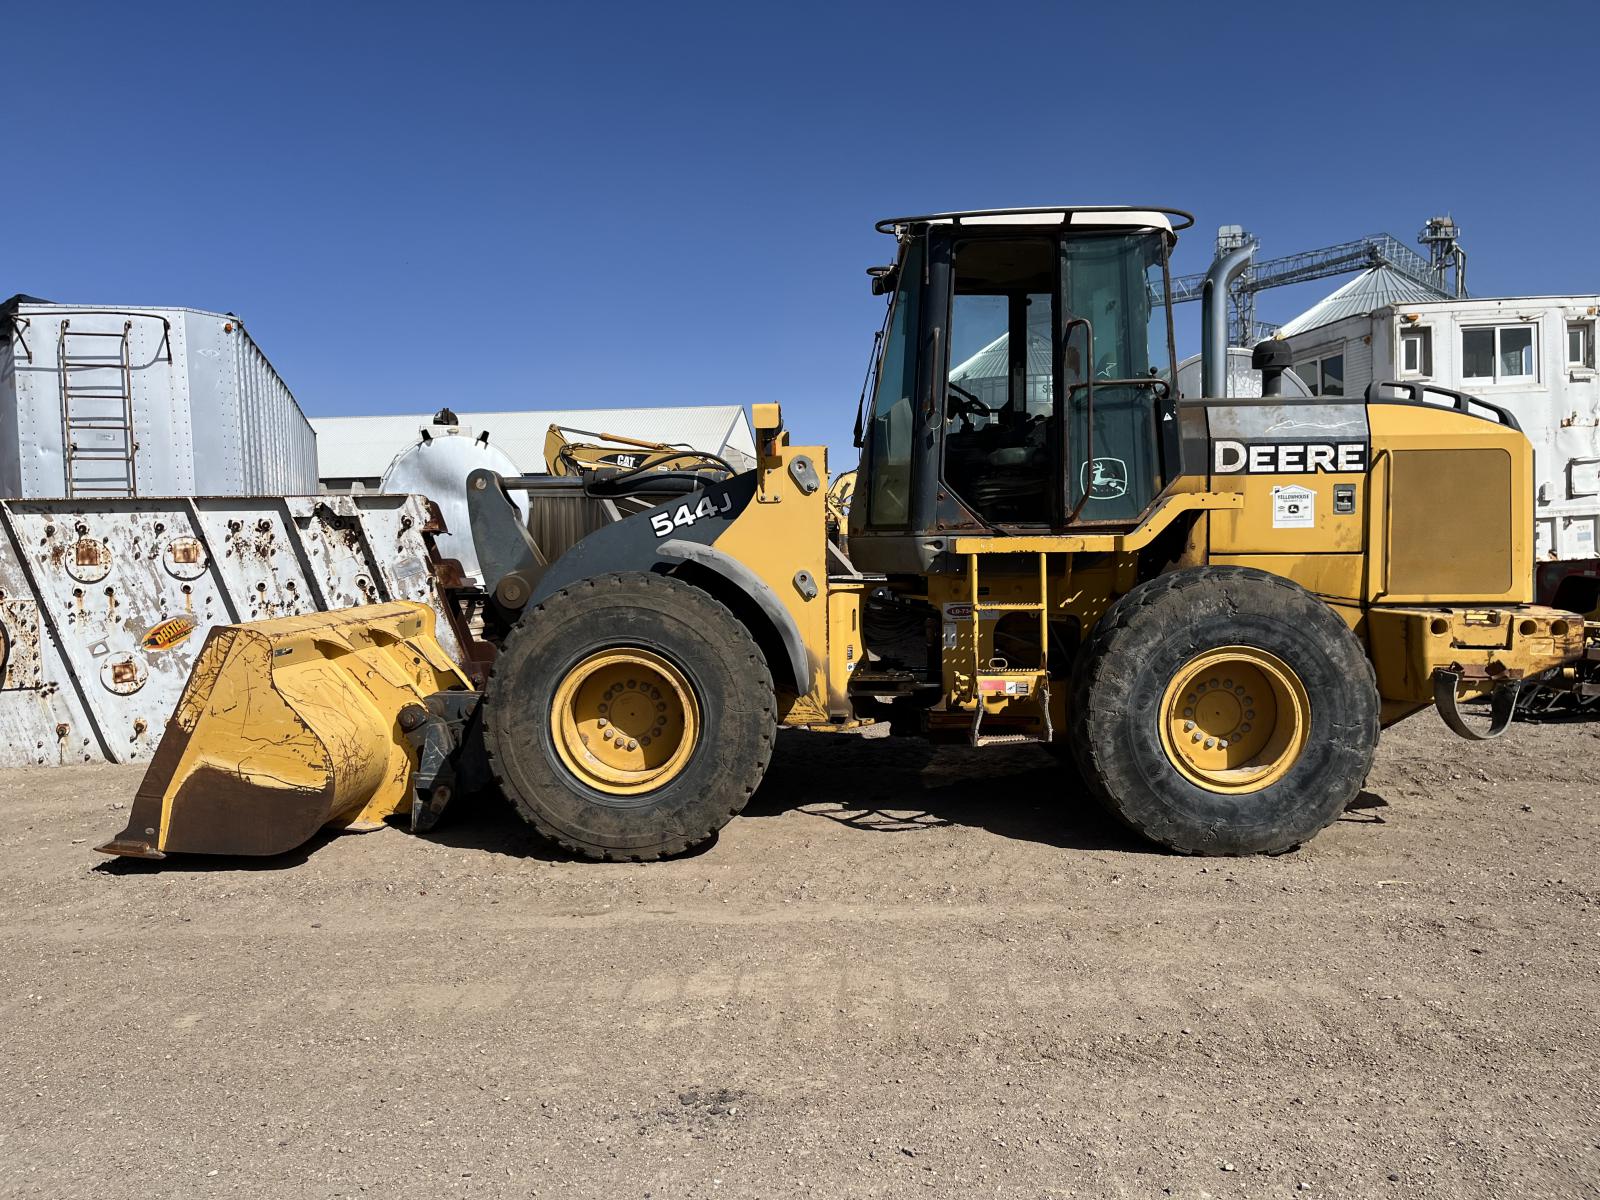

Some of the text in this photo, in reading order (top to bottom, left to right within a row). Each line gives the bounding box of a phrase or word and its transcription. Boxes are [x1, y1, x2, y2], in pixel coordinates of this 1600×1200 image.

[617, 455, 635, 467] CAT
[1214, 440, 1364, 473] DEERE
[650, 493, 732, 537] 544J
